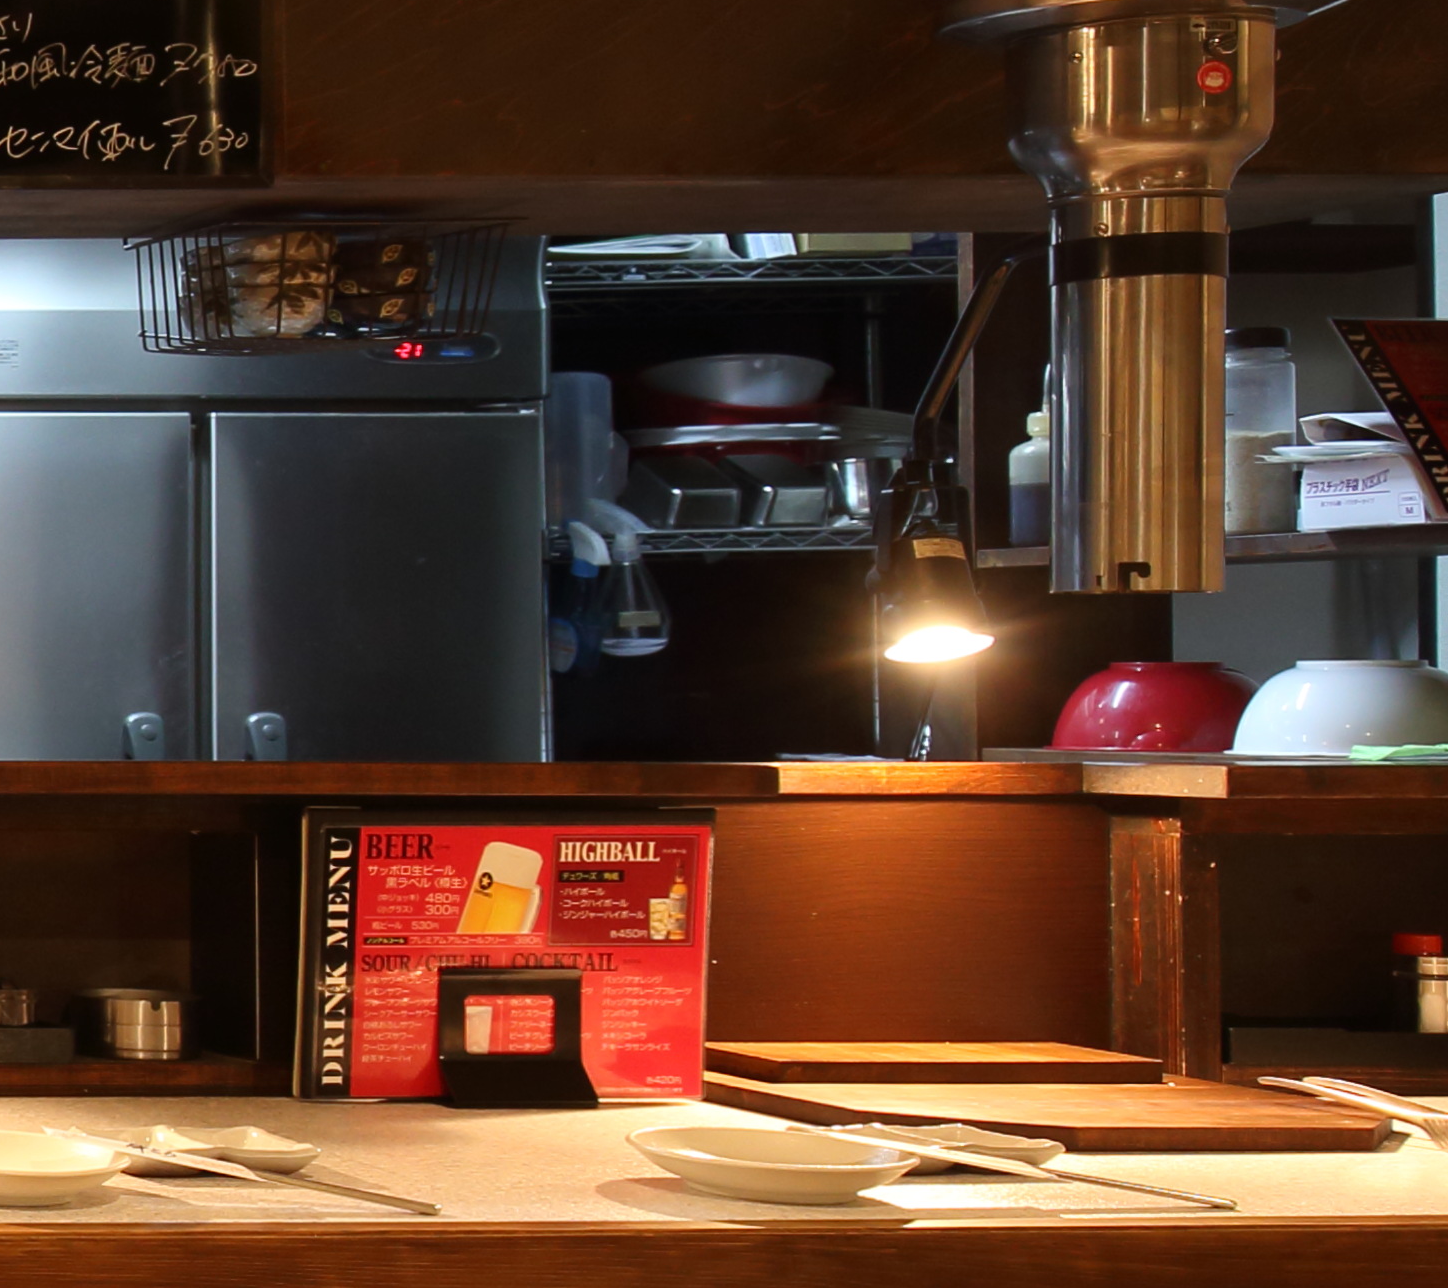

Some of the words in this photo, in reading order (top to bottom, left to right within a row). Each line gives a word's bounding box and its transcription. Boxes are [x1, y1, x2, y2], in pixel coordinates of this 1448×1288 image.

[365, 834, 435, 860] BEER
[559, 841, 661, 862] HIGHBALL
[367, 865, 456, 877] サッポロ生ビール
[327, 836, 352, 948] MENU
[425, 892, 460, 904] 480円
[425, 904, 459, 916] 300円
[511, 953, 617, 972] COCKTAIL
[321, 961, 349, 1085] DRINK
